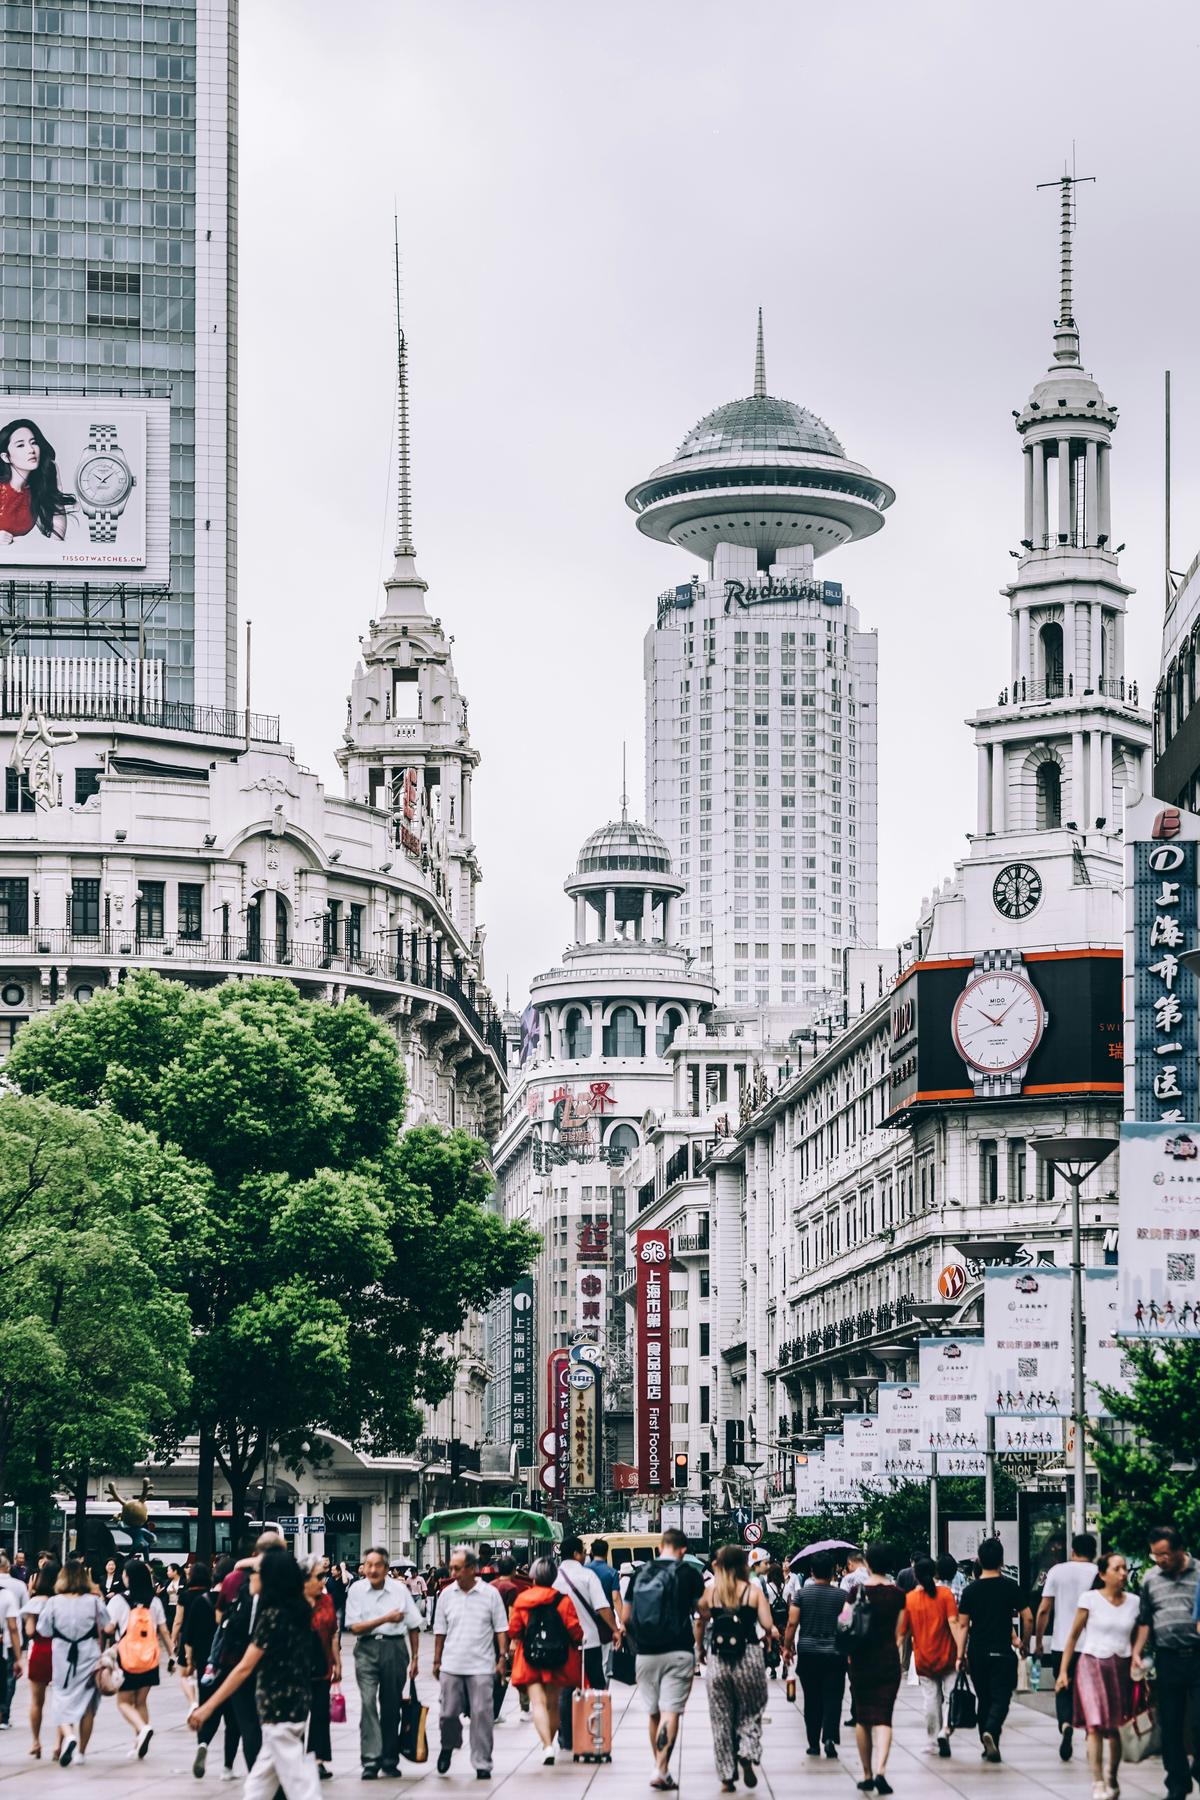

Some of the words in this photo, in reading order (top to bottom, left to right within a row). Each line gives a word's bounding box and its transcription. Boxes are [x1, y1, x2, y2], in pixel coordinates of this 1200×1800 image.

[62, 555, 142, 563] TISSOTWATCHES.CN
[677, 592, 690, 601] BLU
[724, 574, 822, 615] Radisson
[825, 589, 842, 598] BLU
[1099, 1023, 1121, 1031] SWI
[646, 1270, 662, 1400] 上海市第一食品商店
[514, 1317, 525, 1449] 上海市第一百货商店
[649, 1407, 660, 1430] First
[649, 1433, 660, 1485] Foodhall
